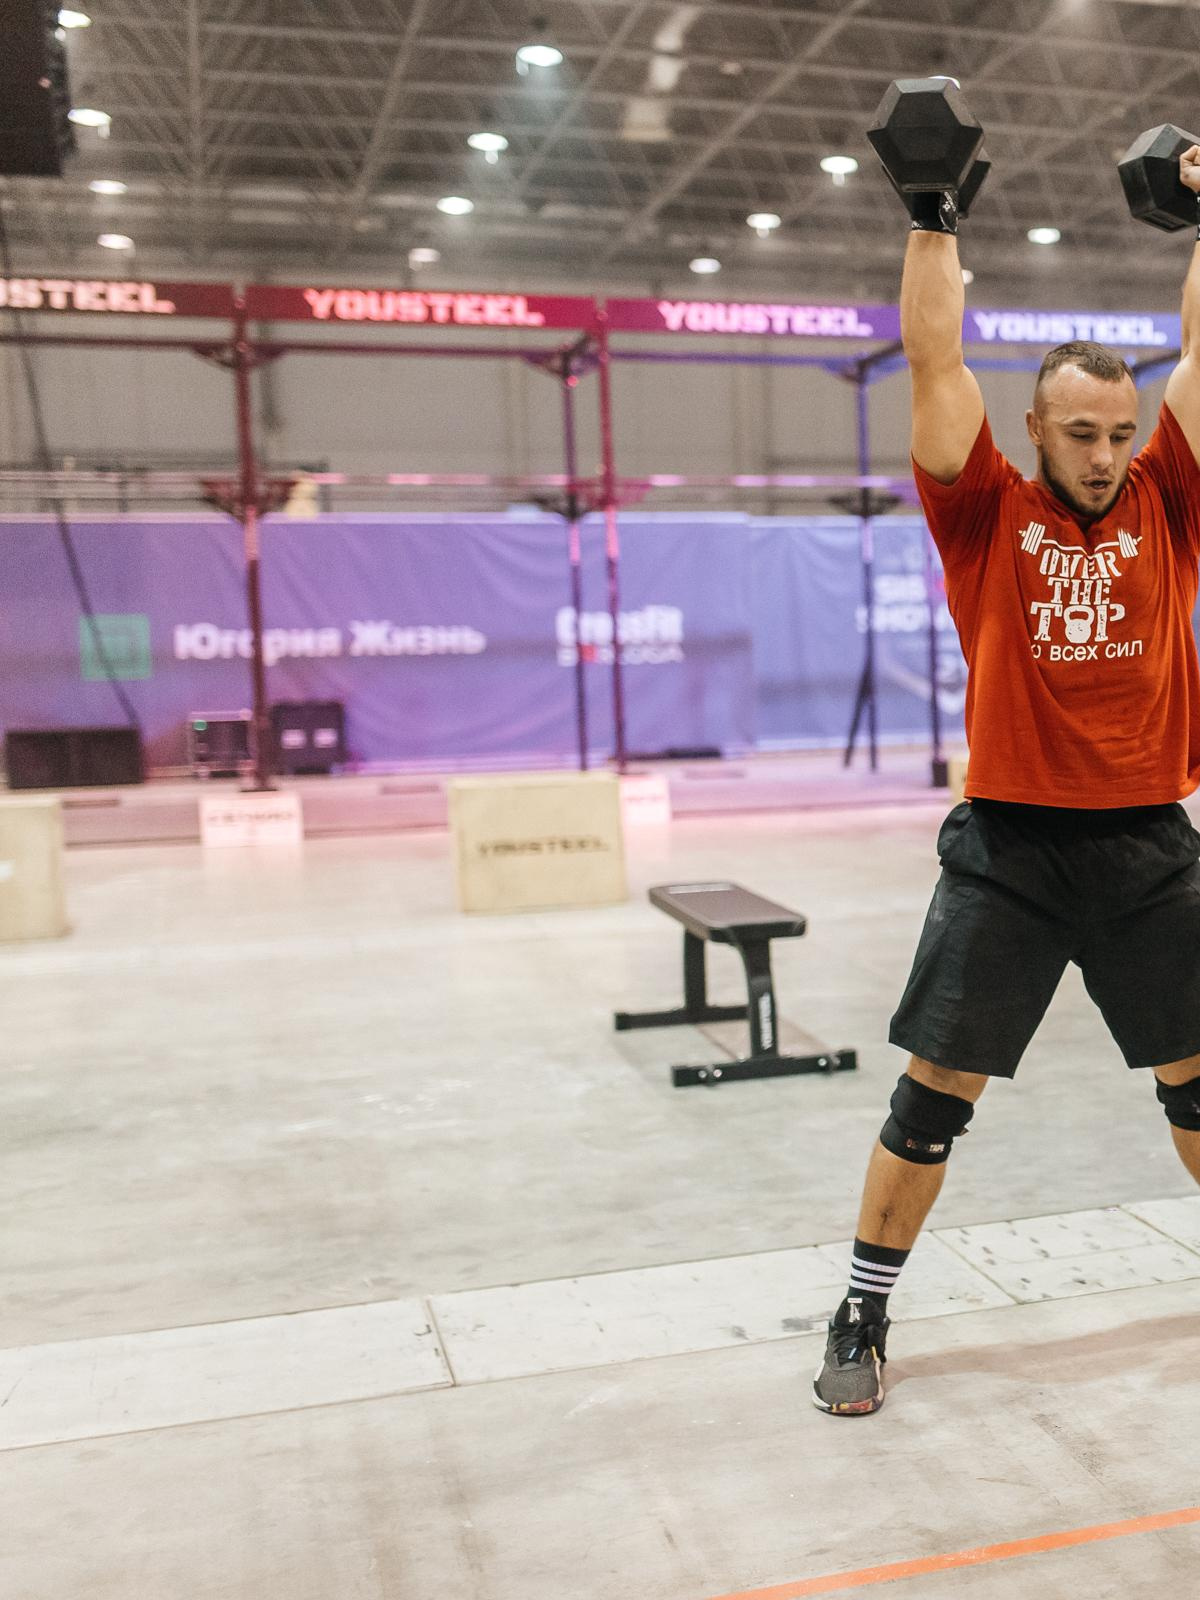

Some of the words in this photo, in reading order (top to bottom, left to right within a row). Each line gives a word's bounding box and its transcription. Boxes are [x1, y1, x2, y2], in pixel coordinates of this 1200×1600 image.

[303, 288, 546, 327] YOUSTEEL
[657, 300, 874, 337] YOUSTEEL
[973, 311, 1168, 345] YOUSTEEL
[1039, 548, 1122, 580] OVER
[1047, 576, 1112, 606] THE
